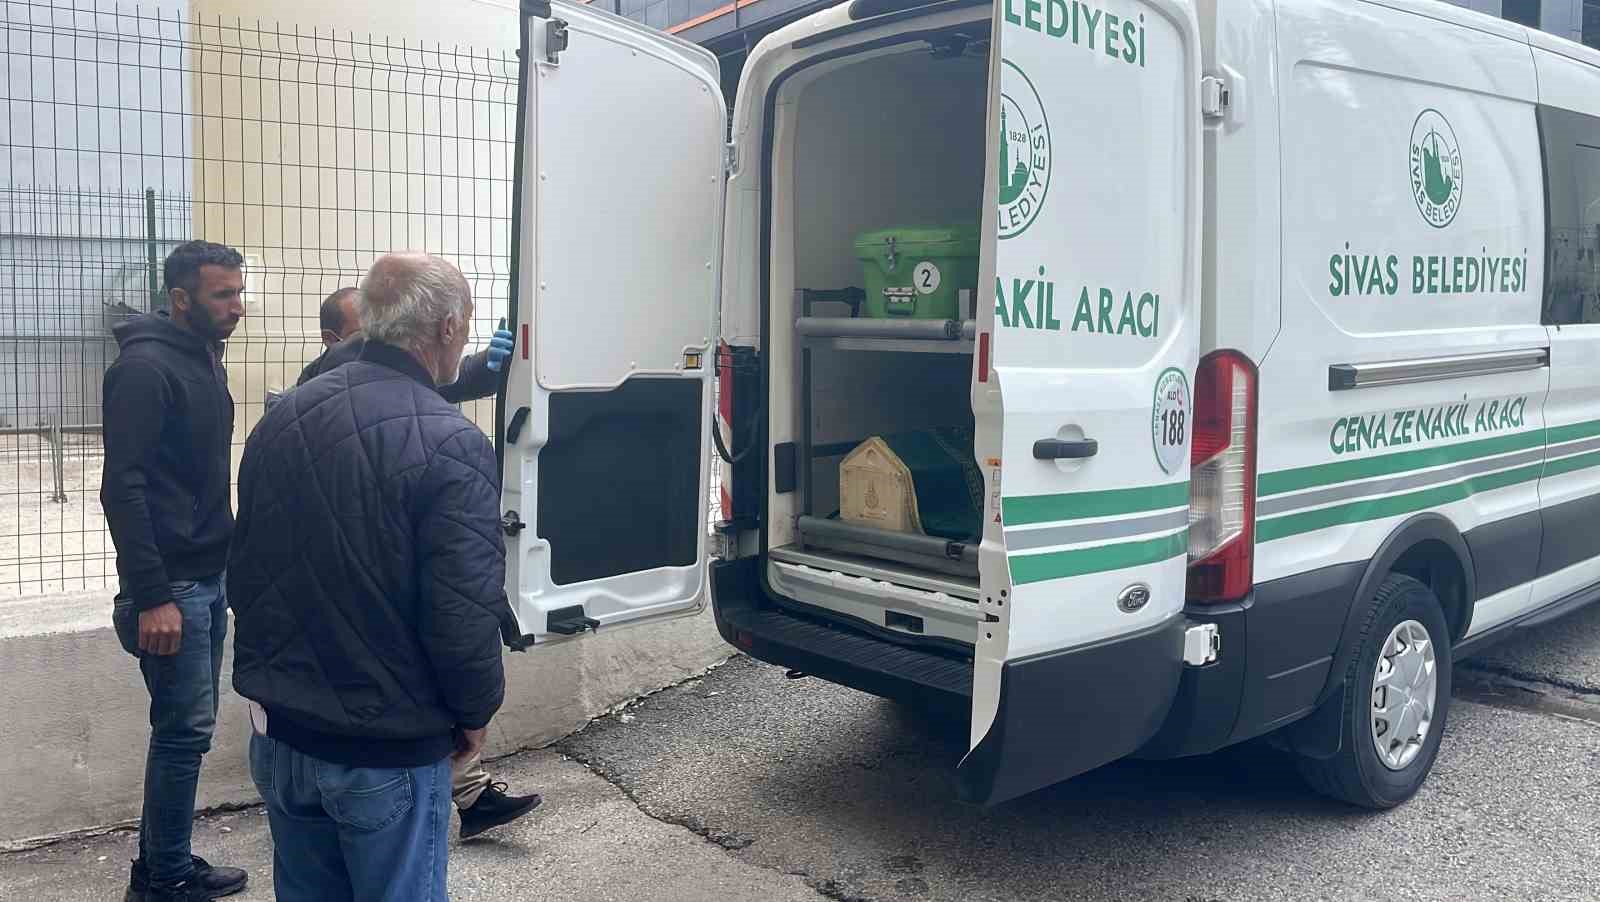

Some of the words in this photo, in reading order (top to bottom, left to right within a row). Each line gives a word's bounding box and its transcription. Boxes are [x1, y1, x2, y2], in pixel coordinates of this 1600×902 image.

[921, 269, 932, 288] 2
[1328, 241, 1399, 297] SİVAS
[1412, 246, 1528, 294] BELEDİYESİ
[1071, 286, 1160, 338] ARACI
[1162, 409, 1184, 446] 188
[1329, 410, 1416, 455] CENAZE
[1415, 392, 1470, 441] NAKİL
[1474, 396, 1528, 433] ARACI
